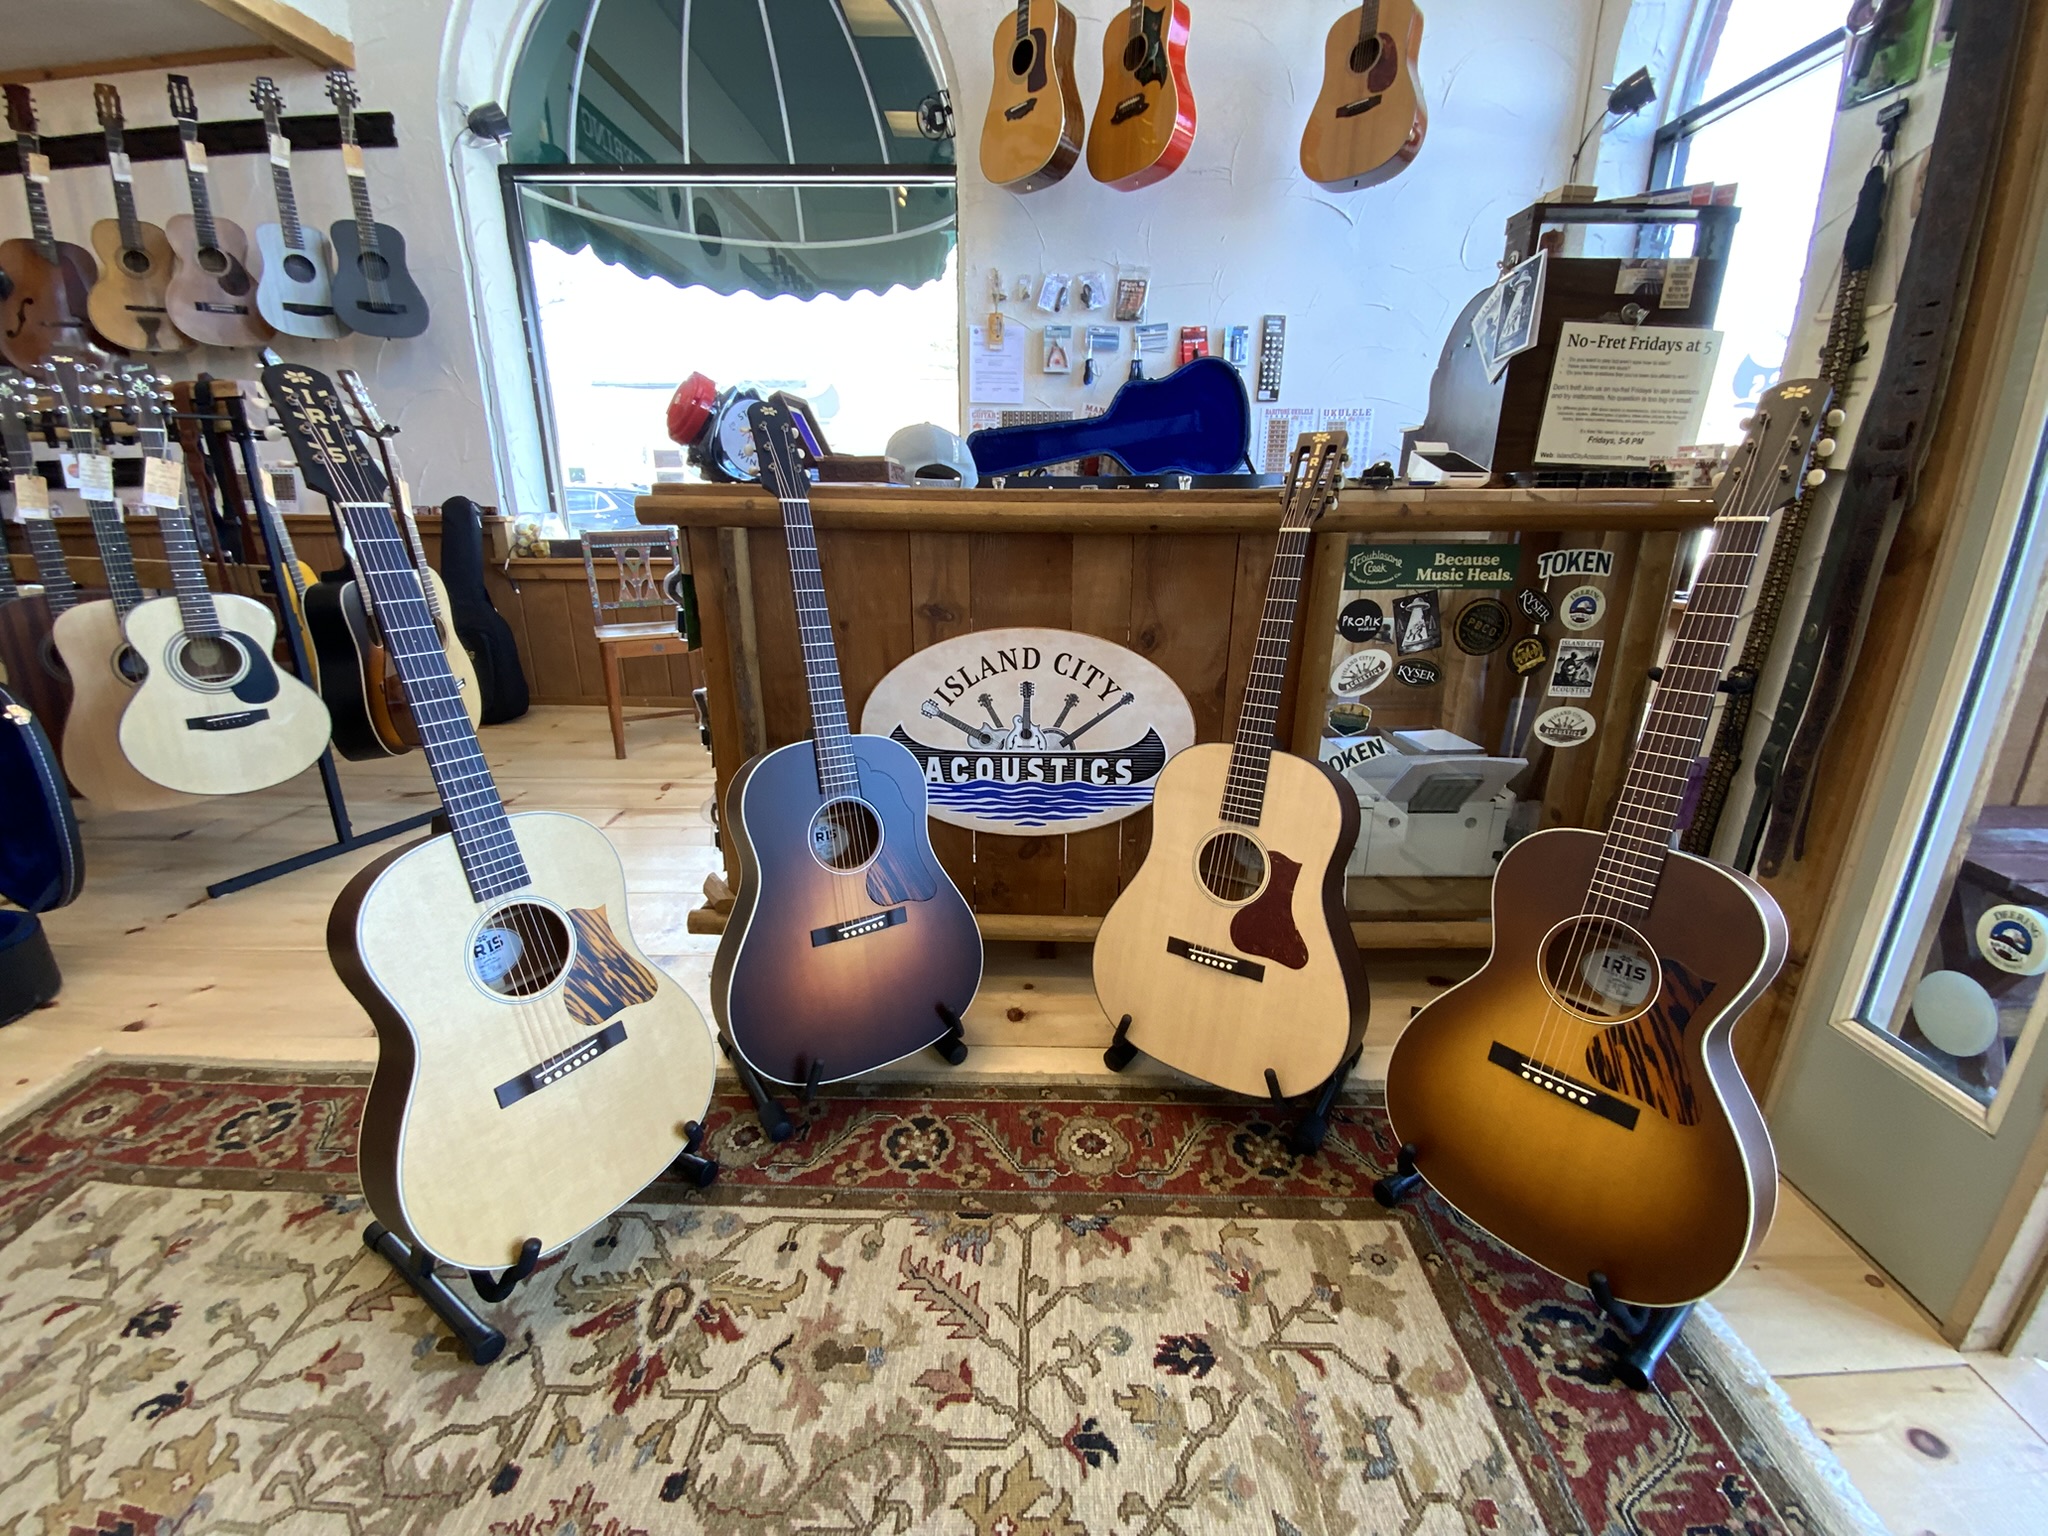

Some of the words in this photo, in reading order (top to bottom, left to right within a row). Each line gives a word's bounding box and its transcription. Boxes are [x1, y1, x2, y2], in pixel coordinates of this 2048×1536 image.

[1567, 333, 1626, 349] No-Fret
[1629, 336, 1682, 355] Fridays
[1686, 340, 1701, 352] at
[1703, 341, 1713, 354] 5
[1323, 409, 1372, 417] UKULELE
[300, 388, 348, 464] IRIS
[1587, 436, 1616, 445] Fridays,
[1631, 437, 1645, 445] PM
[1363, 561, 1388, 576] Creek
[1434, 553, 1500, 566] Because
[1541, 551, 1611, 576] TOKEN
[1416, 568, 1464, 581] Music
[1467, 568, 1513, 581] Heals.
[1520, 589, 1550, 622] KYSER
[1570, 589, 1601, 602] DEERING
[933, 647, 1041, 707] ISLAND
[1054, 653, 1122, 703] CITY
[1346, 667, 1382, 689] ACOUSTICS
[1397, 665, 1435, 684] KYSER
[1546, 728, 1582, 737] ACOUSTICS
[1325, 738, 1386, 772] OKEN
[925, 757, 1134, 785] ACOUSTICS
[1993, 910, 2042, 939] DEERING
[1602, 955, 1647, 981] IRIS
